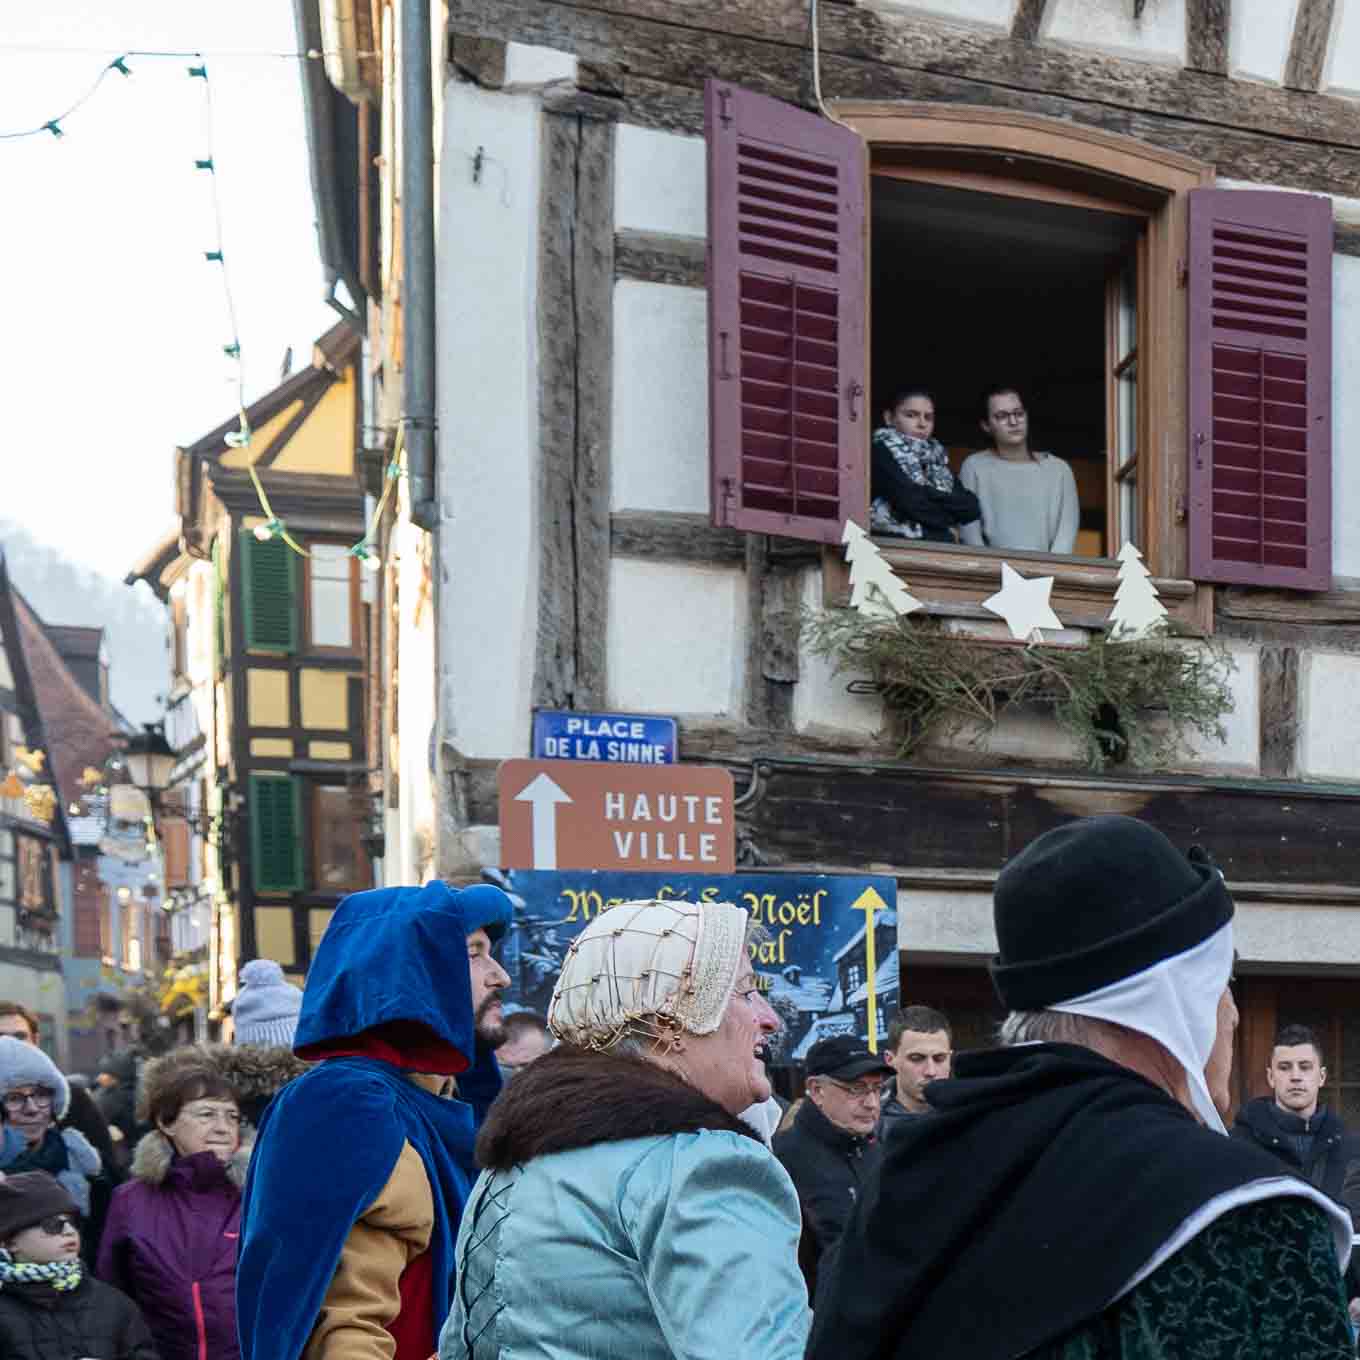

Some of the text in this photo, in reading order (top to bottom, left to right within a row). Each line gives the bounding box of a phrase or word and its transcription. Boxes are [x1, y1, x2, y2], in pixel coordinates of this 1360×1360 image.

[567, 718, 645, 739] PLACE
[544, 737, 665, 764] DE LA SINNE
[605, 791, 723, 825] HAUTE
[613, 831, 717, 862] VILLE
[743, 889, 828, 926] Noël
